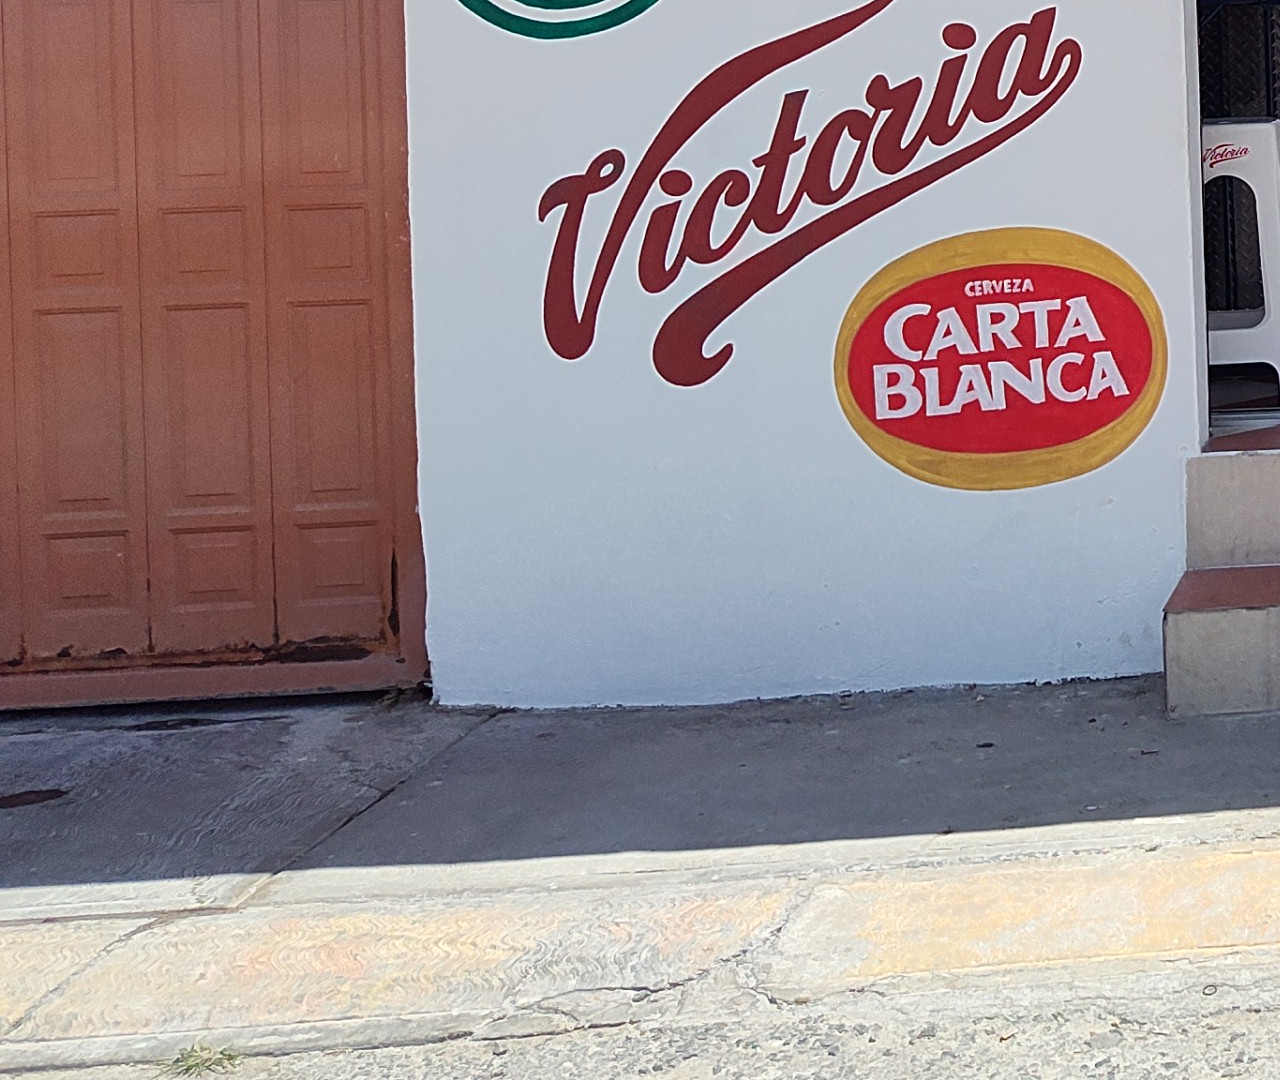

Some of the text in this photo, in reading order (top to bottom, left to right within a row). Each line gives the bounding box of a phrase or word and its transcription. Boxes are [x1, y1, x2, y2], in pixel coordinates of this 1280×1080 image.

[963, 277, 1035, 297] CERVEZA
[883, 295, 1106, 362] CARTA
[872, 351, 1131, 421] BLANCA
